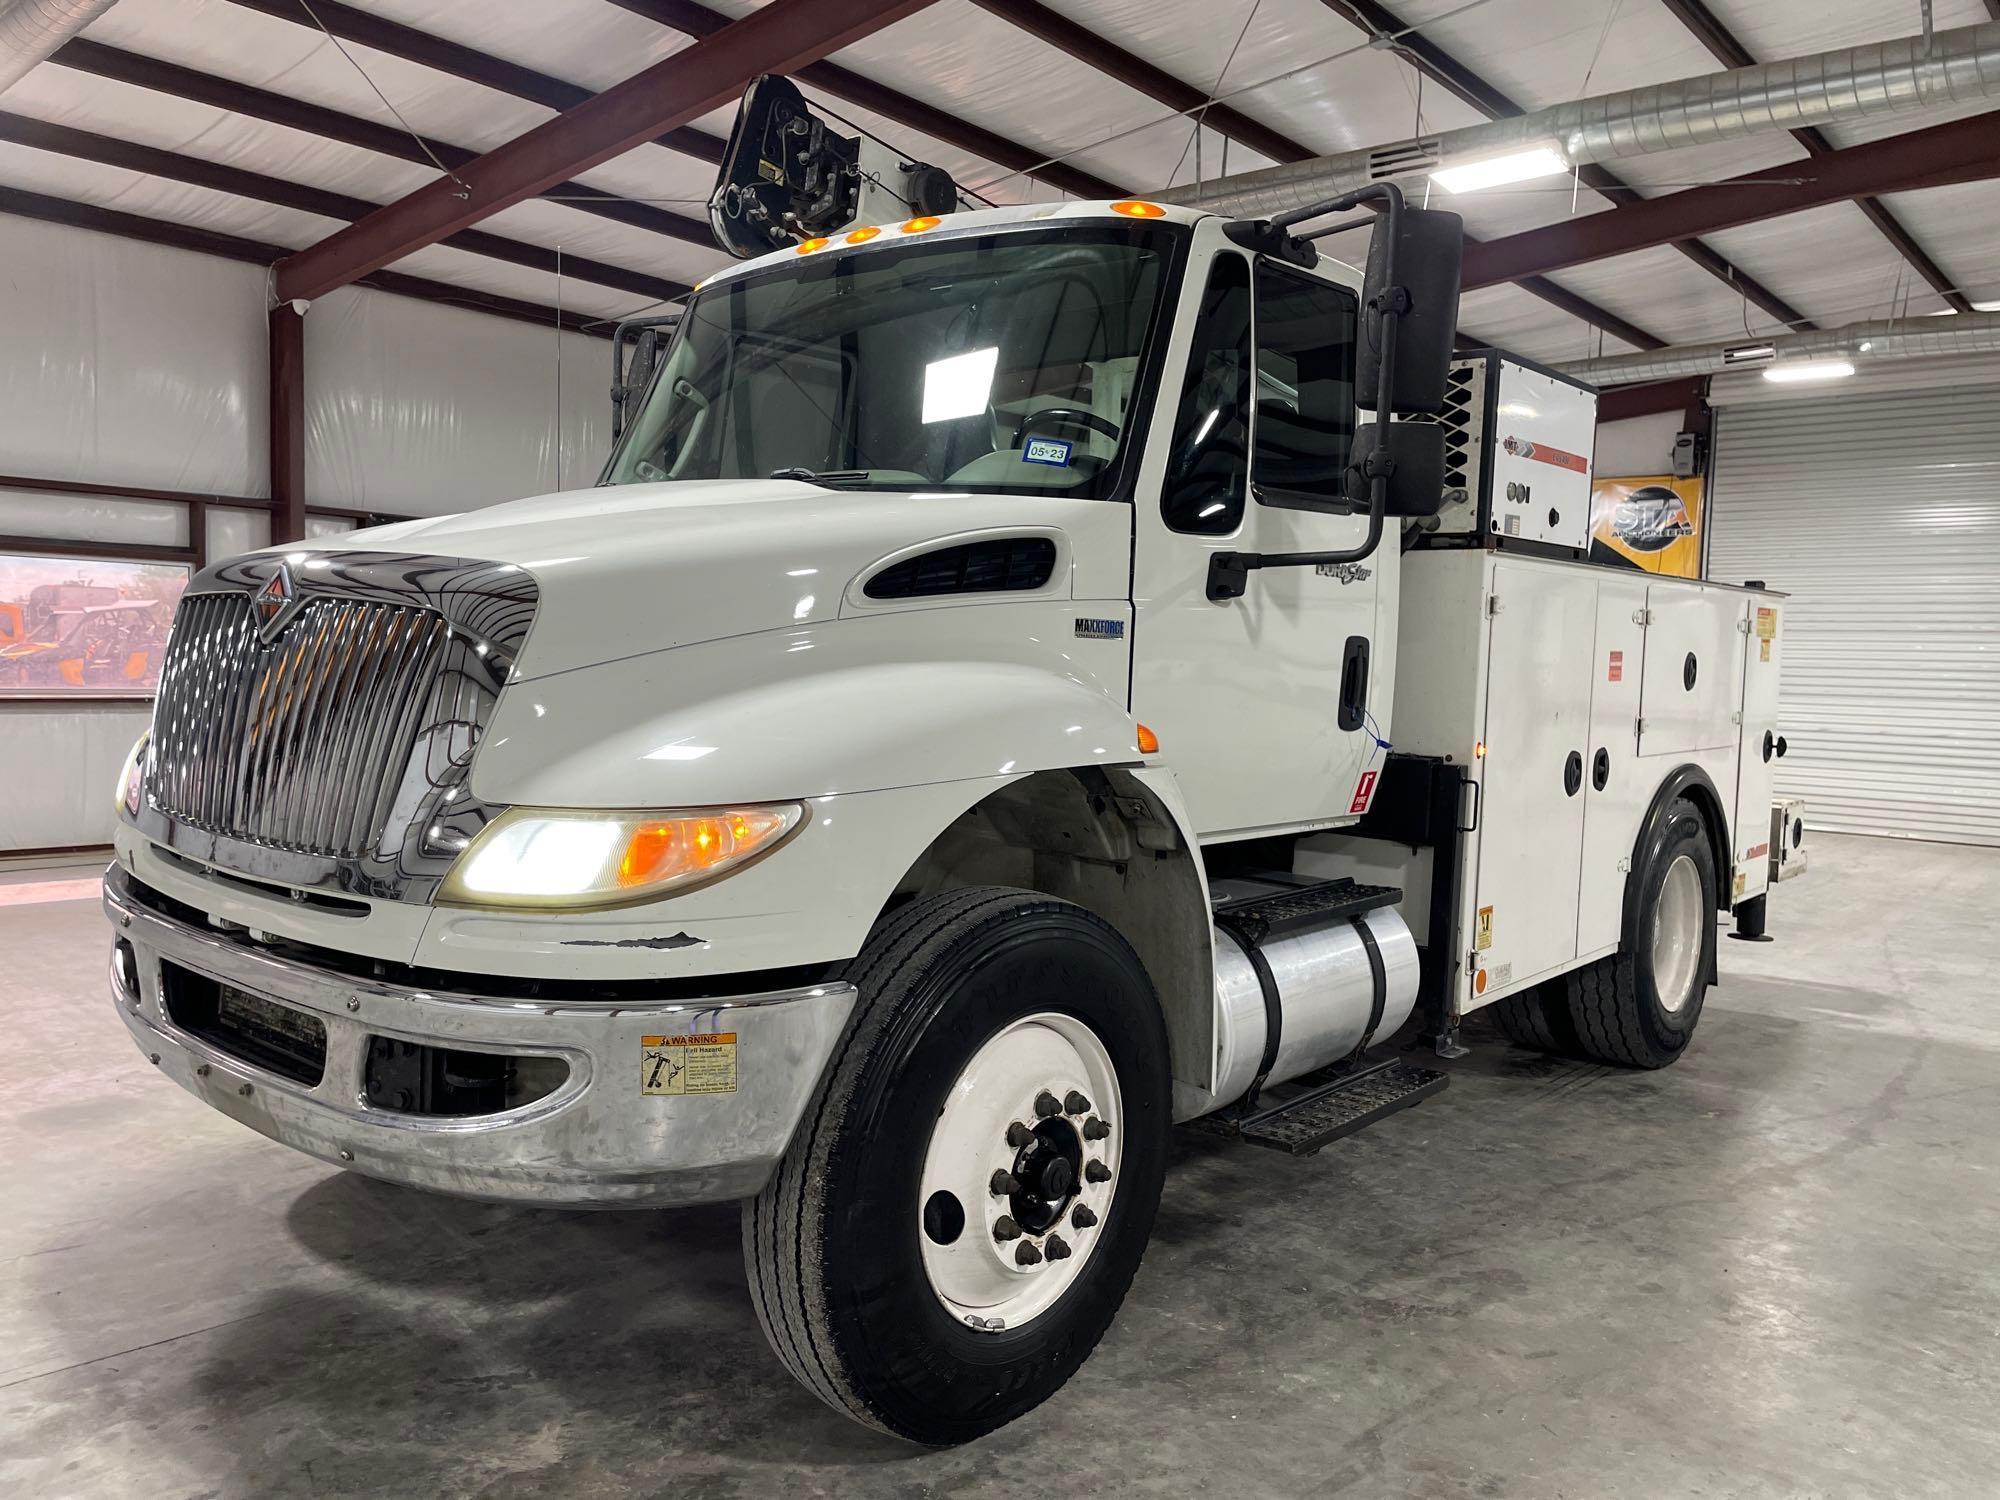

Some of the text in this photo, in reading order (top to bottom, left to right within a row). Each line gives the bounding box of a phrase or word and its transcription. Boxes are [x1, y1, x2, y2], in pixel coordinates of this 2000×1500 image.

[1030, 446, 1065, 459] 05 23
[1614, 499, 1693, 532] STA
[1611, 528, 1693, 538] AUCTIONEERS
[1074, 618, 1125, 635] MAXXFORCE
[671, 1035, 718, 1046] WARNING
